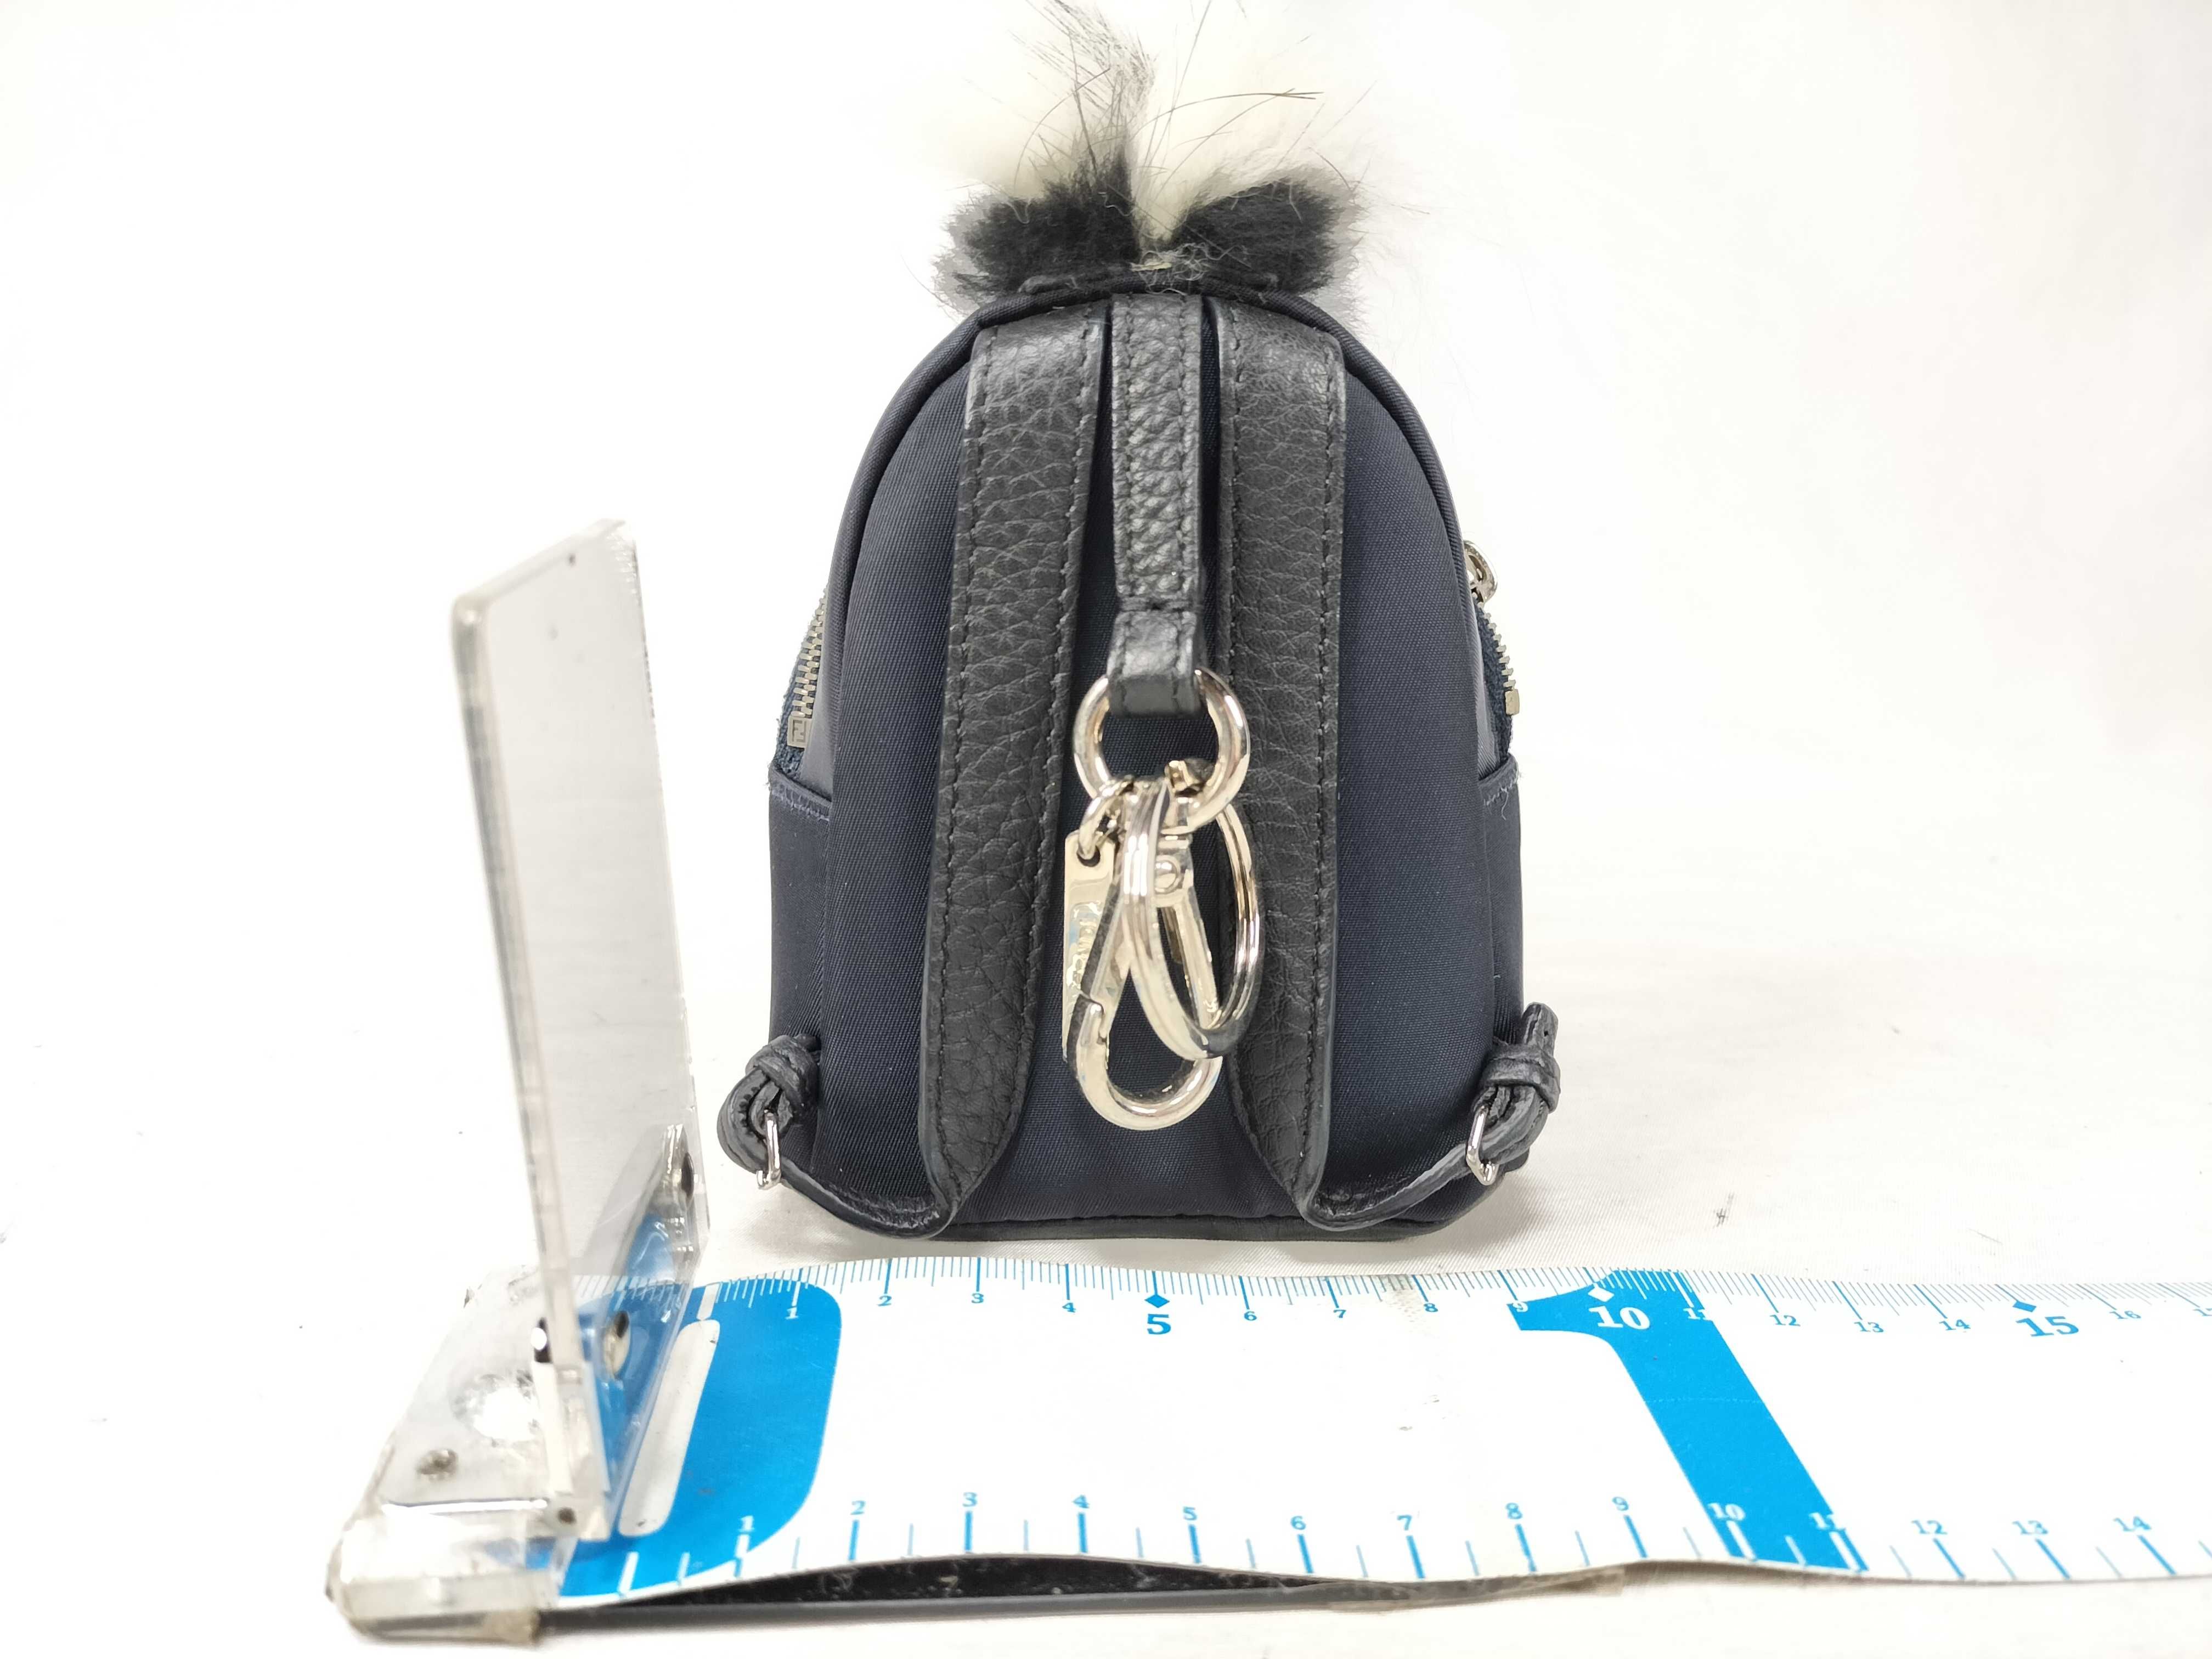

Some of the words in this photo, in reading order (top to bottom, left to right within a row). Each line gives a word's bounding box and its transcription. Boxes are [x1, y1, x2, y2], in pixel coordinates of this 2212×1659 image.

[786, 1306, 798, 1319] 1
[878, 1295, 892, 1307] 2
[972, 1293, 984, 1305] 3
[1062, 1301, 1076, 1313] 4
[1147, 1313, 1171, 1335] 5
[1244, 1311, 1257, 1322] 6
[1333, 1309, 1346, 1319] 7
[1424, 1302, 1438, 1313] 8
[1512, 1300, 1528, 1312] 9
[1588, 1306, 1651, 1330] 10
[1770, 1314, 1801, 1327] 12
[1854, 1321, 1884, 1333] 13
[1939, 1319, 1971, 1331] 14
[2016, 1316, 2079, 1337] 15
[2109, 1310, 2141, 1319] 16
[739, 1515, 754, 1532] 1
[850, 1500, 865, 1515] 2
[962, 1492, 978, 1507] 3
[1073, 1495, 1090, 1508] 4
[1183, 1506, 1197, 1521] 5
[1290, 1515, 1306, 1530] 6
[1397, 1515, 1413, 1530] 7
[1505, 1503, 1523, 1520] 8
[1612, 1497, 1629, 1511] 9
[1707, 1503, 1745, 1521] 10
[1911, 1520, 1948, 1535] 12
[2012, 1520, 2049, 1535] 13
[2113, 1516, 2152, 1532] 14
